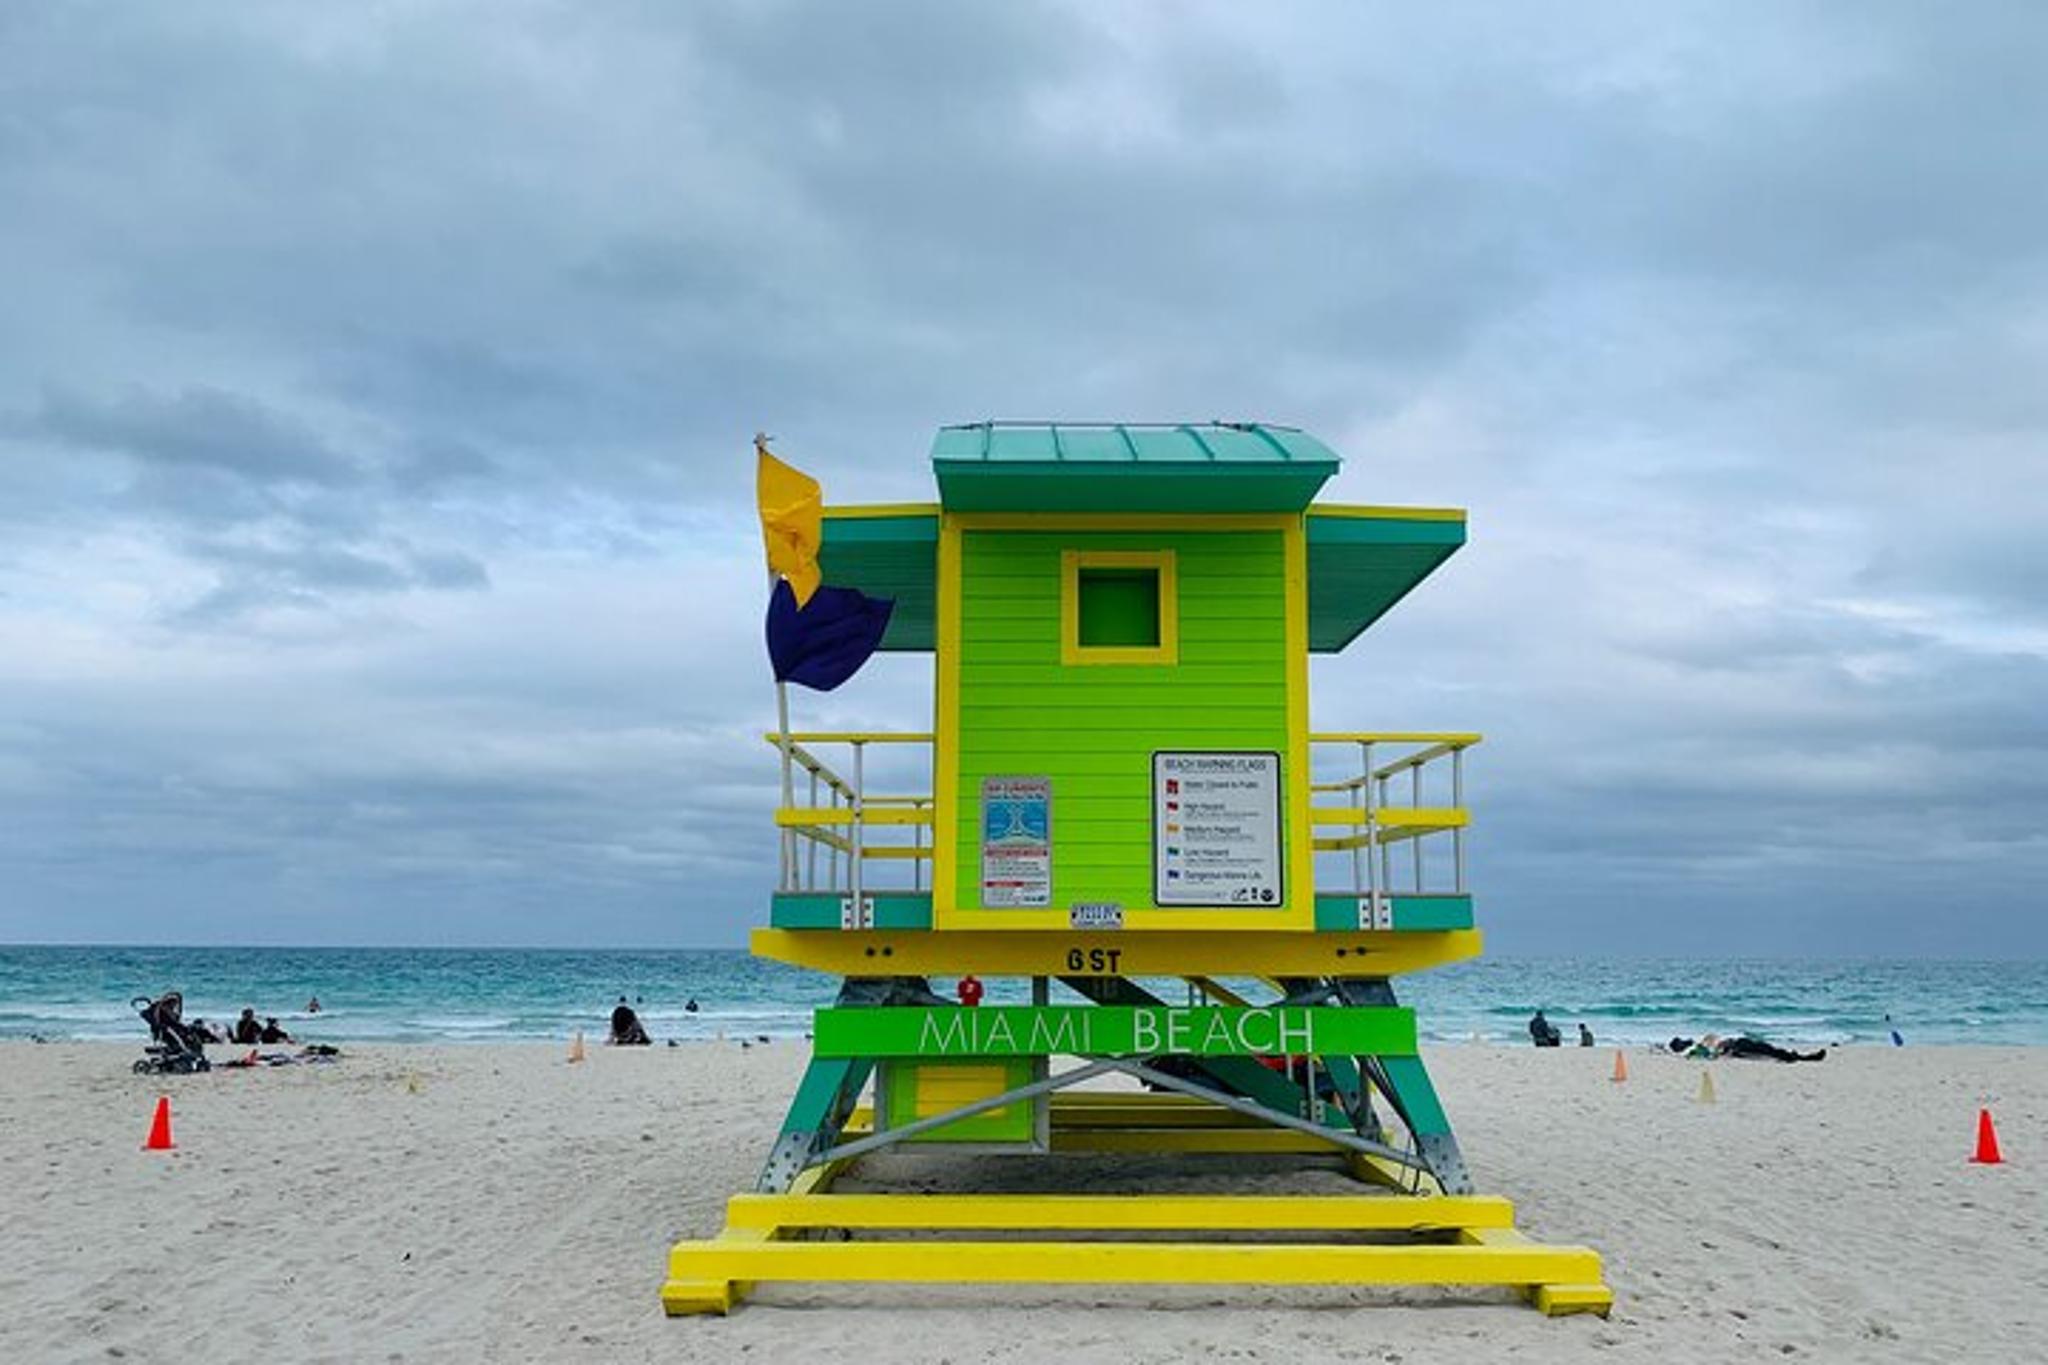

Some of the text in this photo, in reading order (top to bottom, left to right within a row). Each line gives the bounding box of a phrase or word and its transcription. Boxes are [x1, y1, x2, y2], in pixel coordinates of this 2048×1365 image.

[1089, 948, 1122, 974] ST
[918, 1008, 1313, 1053] MIAMI BEACH
